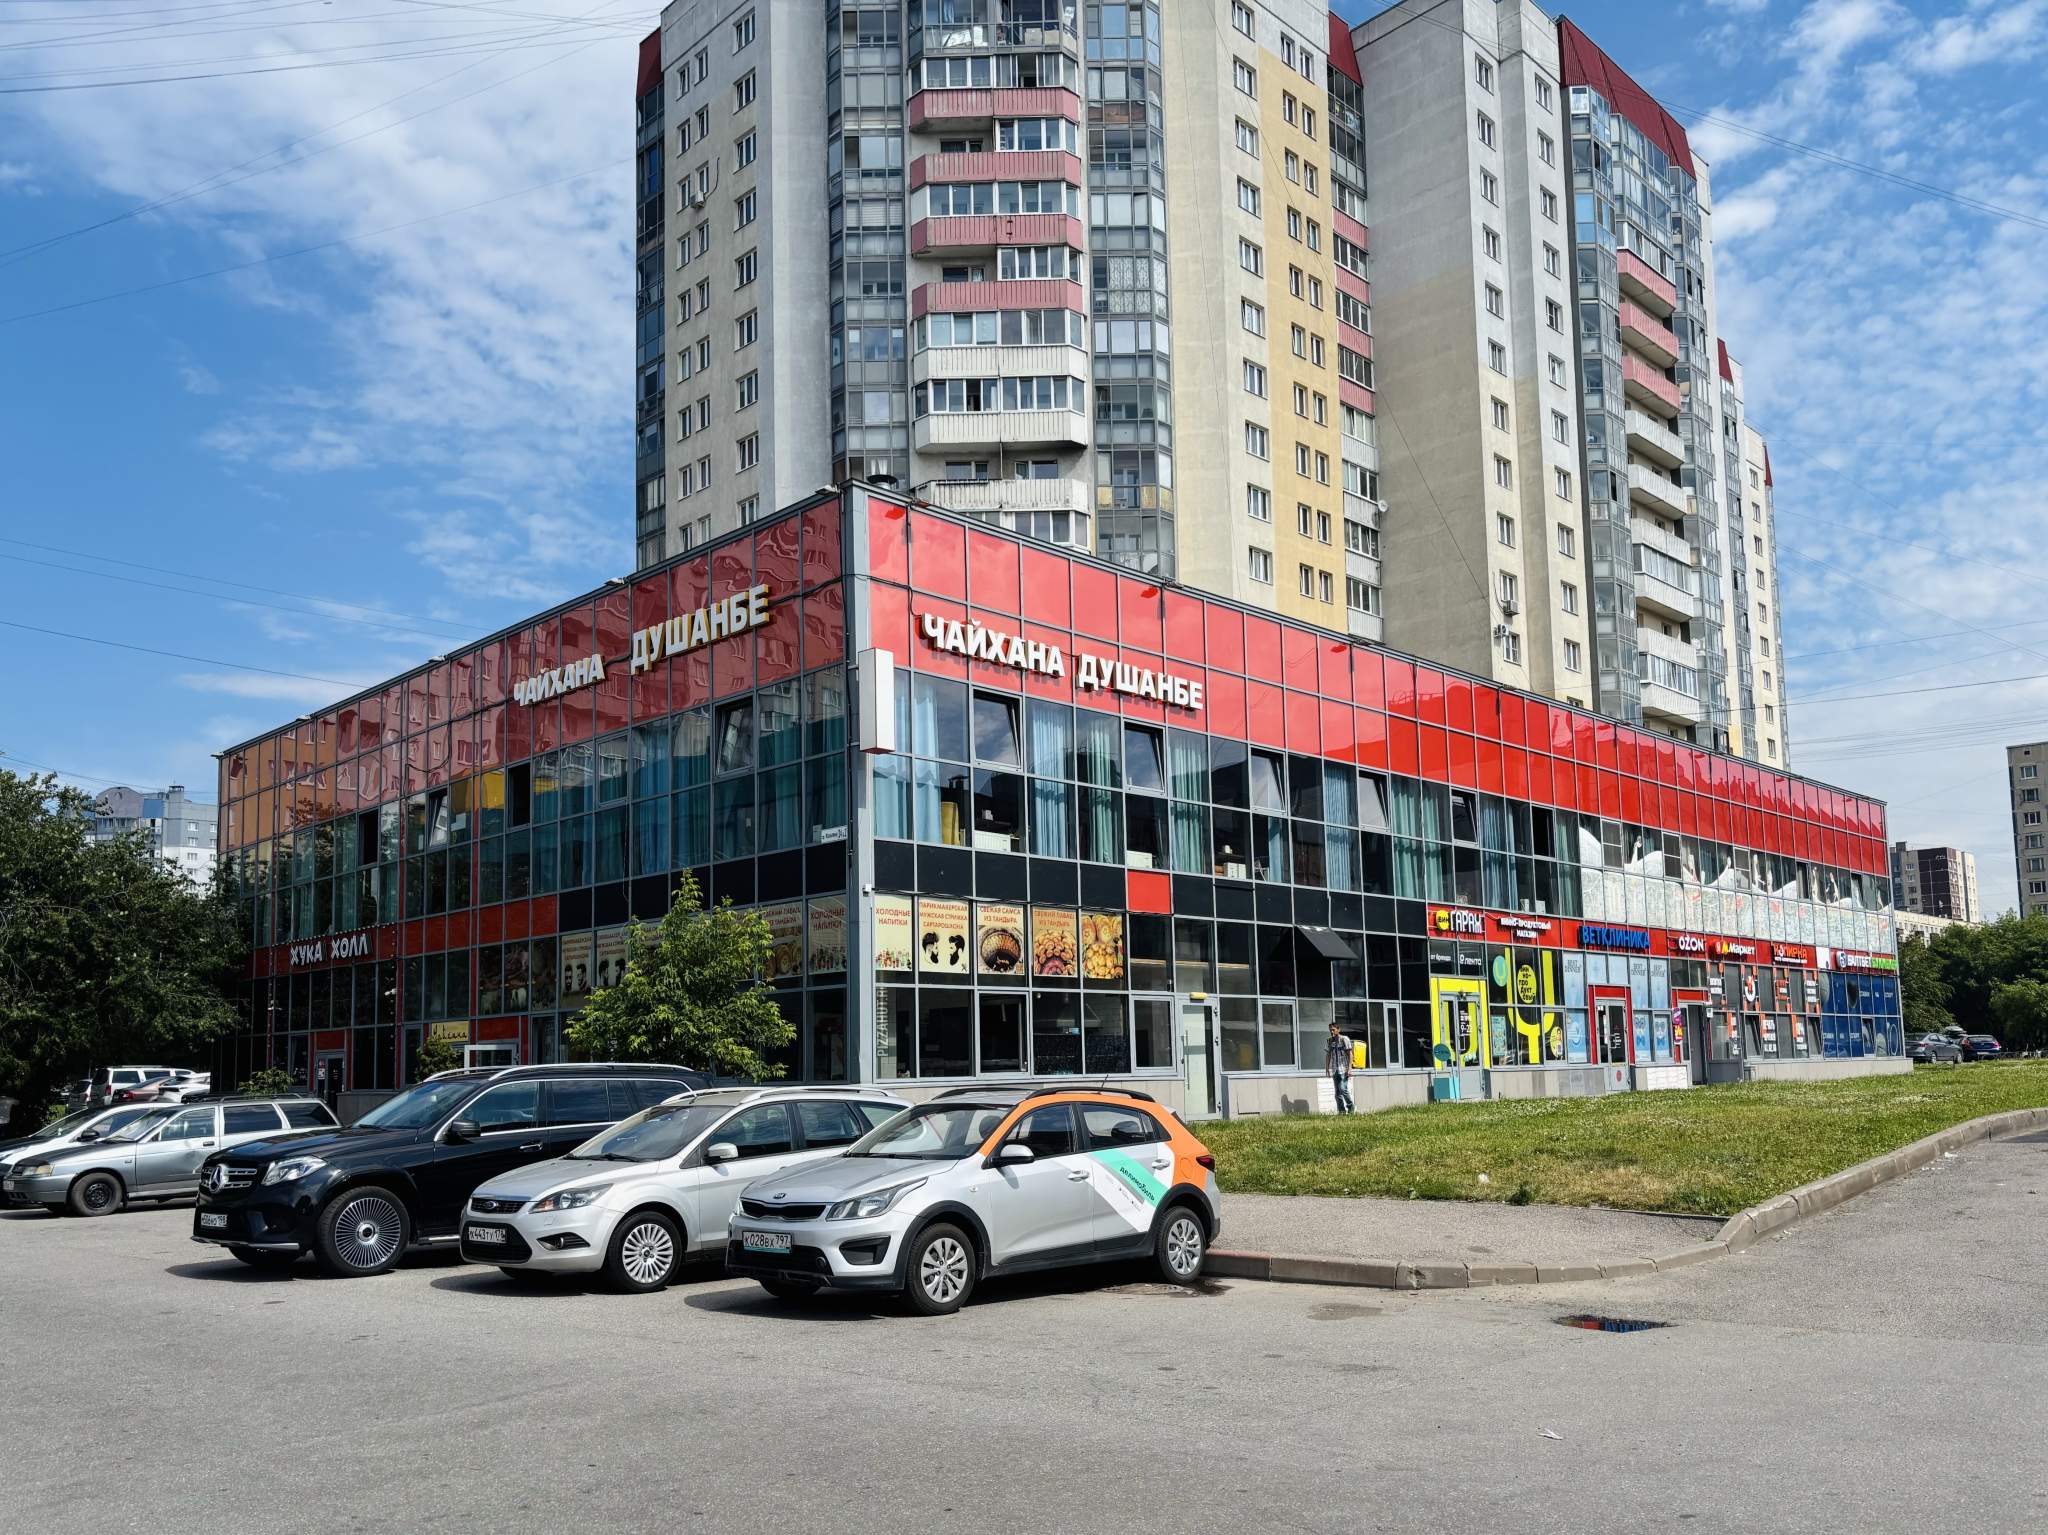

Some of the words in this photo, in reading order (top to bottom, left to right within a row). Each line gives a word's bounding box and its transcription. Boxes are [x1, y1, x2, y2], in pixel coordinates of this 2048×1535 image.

[513, 653, 606, 707] ЧАЙХАНА
[630, 583, 770, 675] ДУШАНБЕ
[921, 612, 1066, 678] ЧАЙХАНА
[1076, 652, 1204, 711] ДУШАНБЕ
[875, 907, 912, 917] ХОЛОДНЫЕ
[980, 905, 1001, 913] СВЕЖАЯ
[879, 918, 908, 926] НАПИТКИ
[1581, 926, 1650, 949] ВЕТКЛИНИКА
[290, 940, 323, 966] ХУКА
[330, 933, 368, 959] ХОЛЛ
[1728, 942, 1755, 955] Маркет
[876, 987, 889, 1057] PIZZAHUT.R
[775, 1234, 789, 1245] 797
